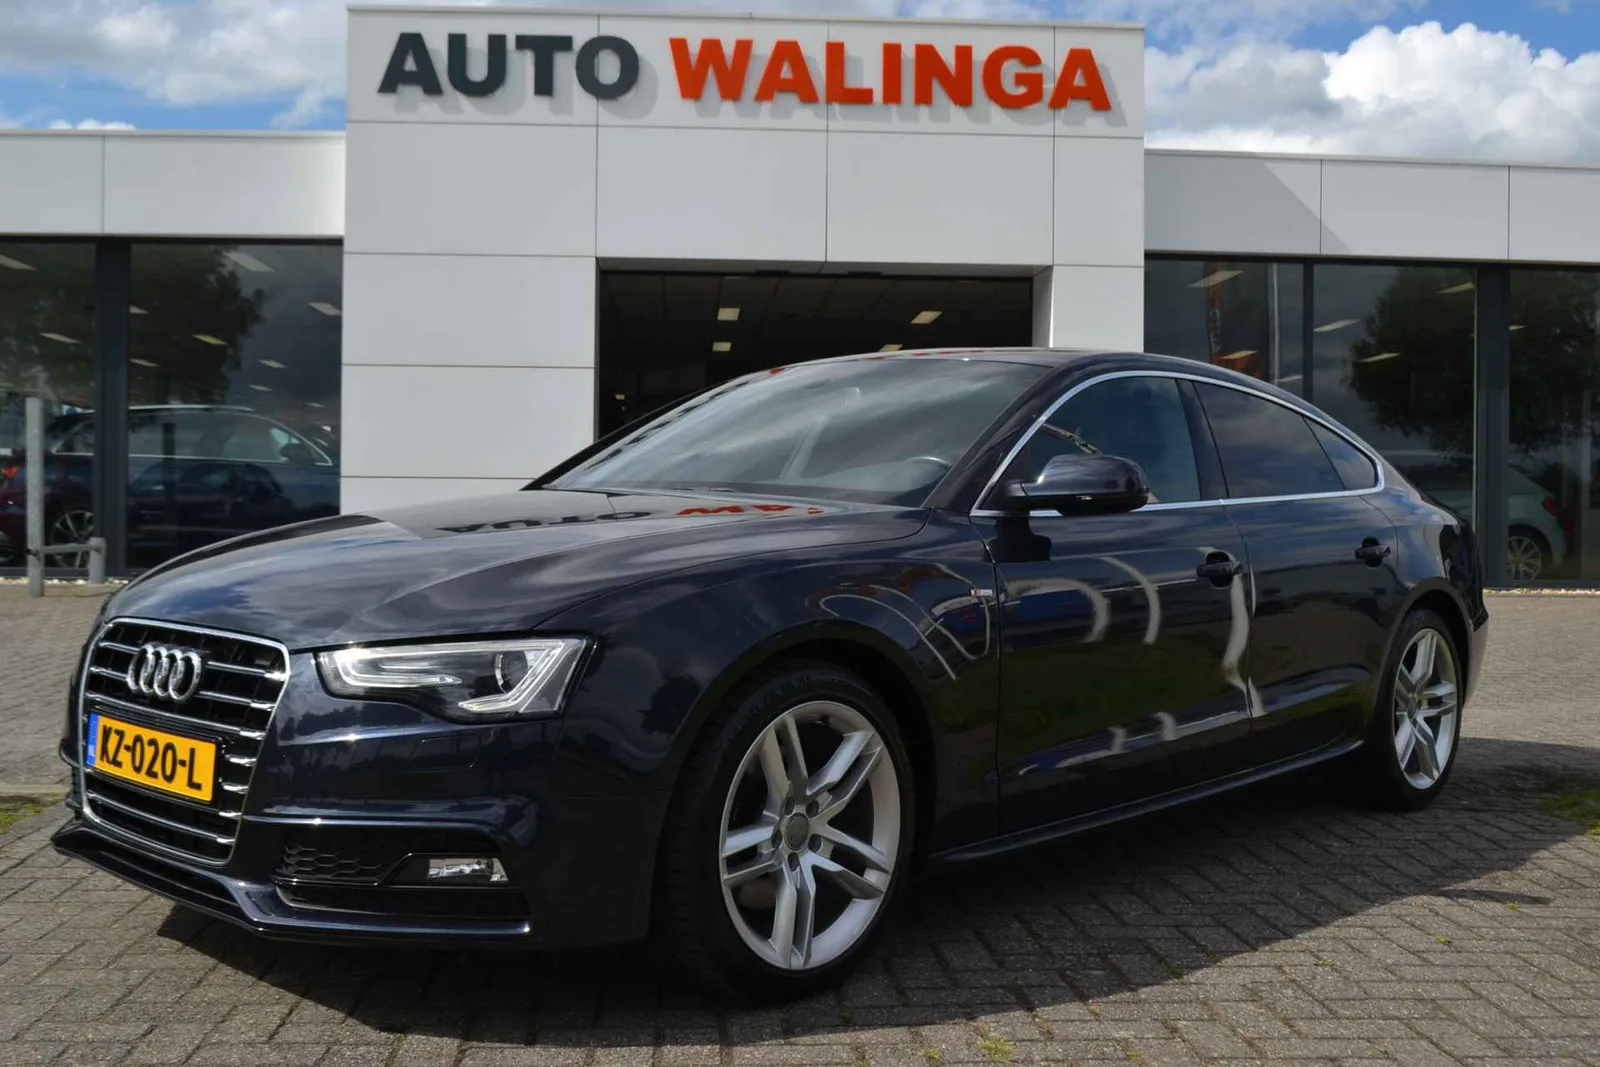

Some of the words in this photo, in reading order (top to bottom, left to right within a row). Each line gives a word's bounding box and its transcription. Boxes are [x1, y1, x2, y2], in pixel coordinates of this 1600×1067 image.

[378, 32, 640, 101] AUTO
[669, 37, 1111, 111] WALINGA
[100, 724, 203, 791] KZ-020-L
